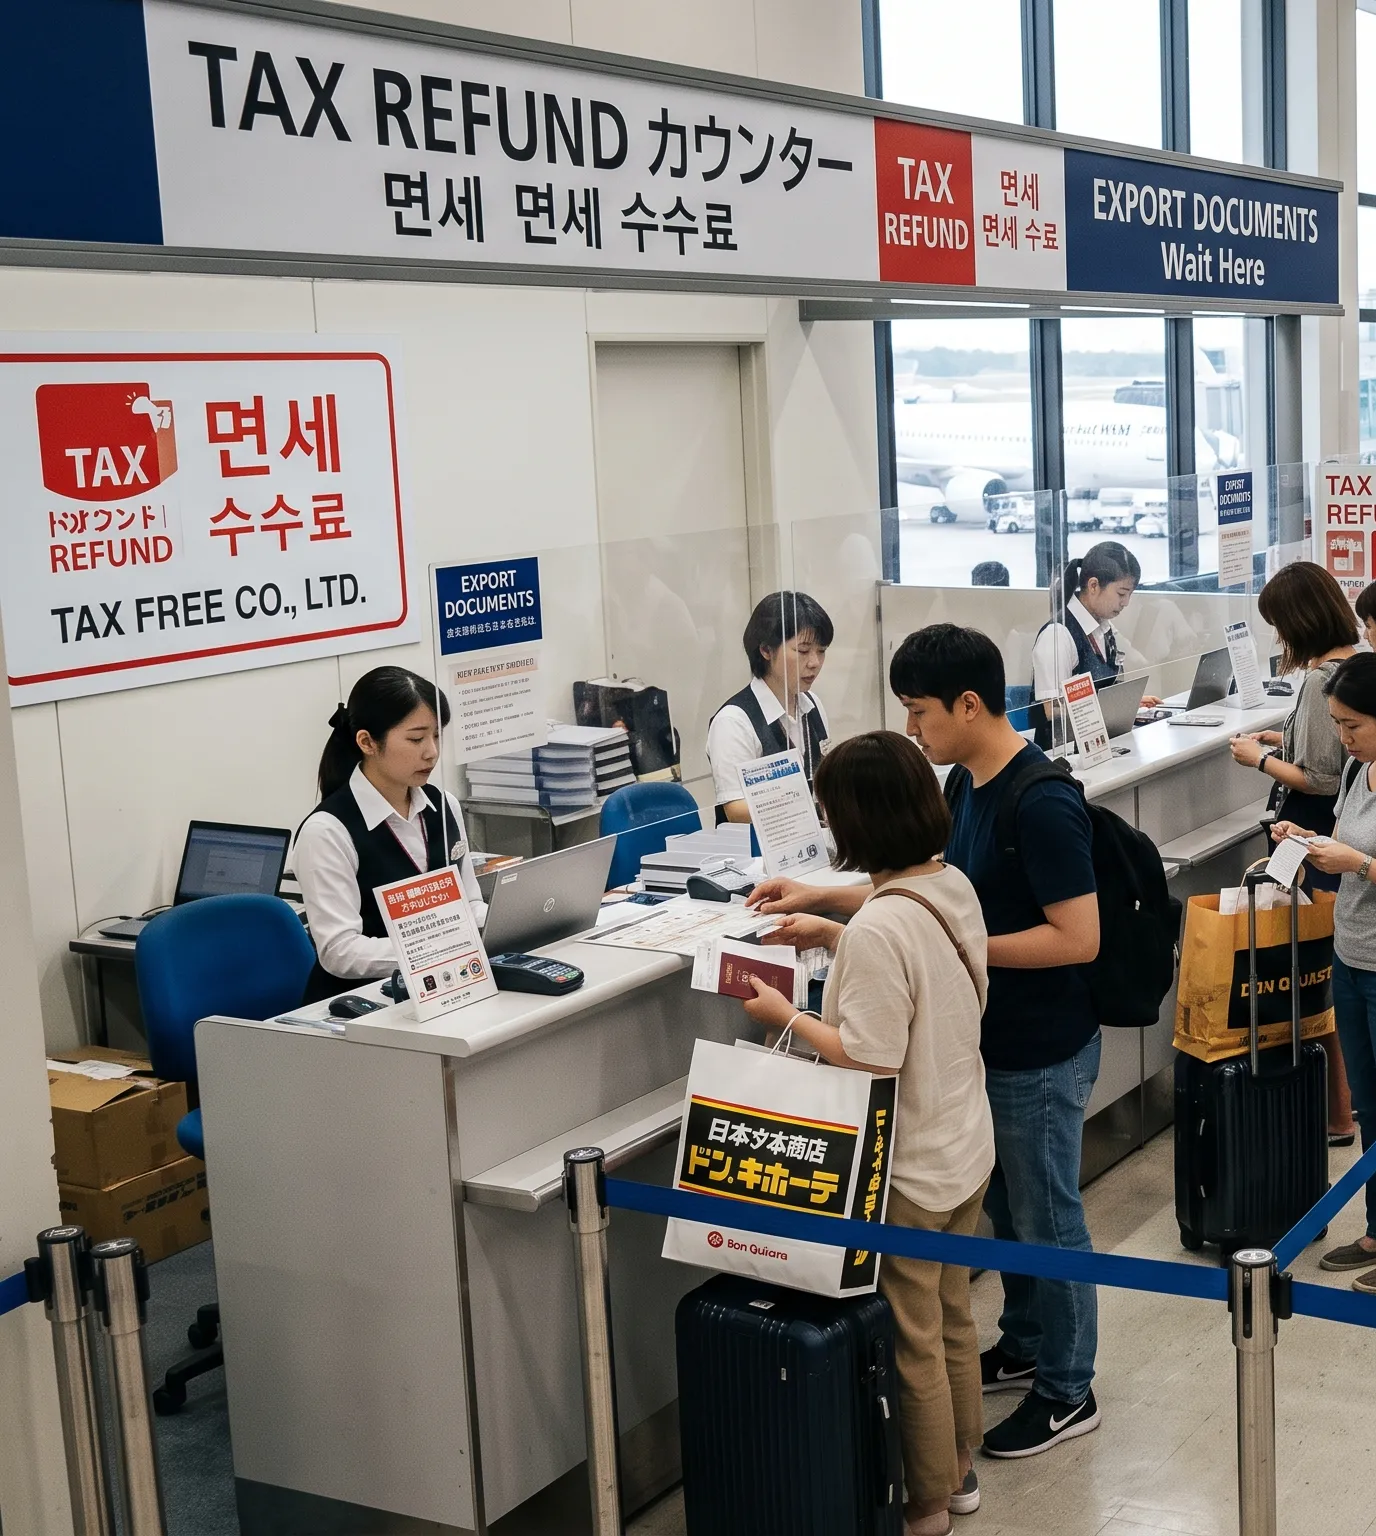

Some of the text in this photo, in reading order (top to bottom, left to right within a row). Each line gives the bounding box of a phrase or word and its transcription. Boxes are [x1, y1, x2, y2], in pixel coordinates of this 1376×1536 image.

[188, 40, 853, 192] TAX REFUND カウンター
[897, 156, 954, 205] TAX
[1000, 170, 1040, 211] 면세
[384, 171, 738, 255] 면세 면세 수수료
[884, 211, 969, 251] REFUND
[982, 213, 1059, 251] 면세 수료
[1093, 177, 1319, 244] EXPORT DOCUMENTS
[1161, 241, 1265, 287] Wait Here
[206, 394, 341, 478] 면세
[65, 445, 150, 488] TAX
[1325, 475, 1372, 496] TAX
[209, 492, 352, 557] 수수료
[50, 535, 173, 573] REFUND
[461, 570, 516, 593] EXPORT
[51, 573, 367, 644] TAX FREE CO., LTD.
[445, 590, 534, 618] DOCUMENTS
[727, 1239, 747, 1251] Bon
